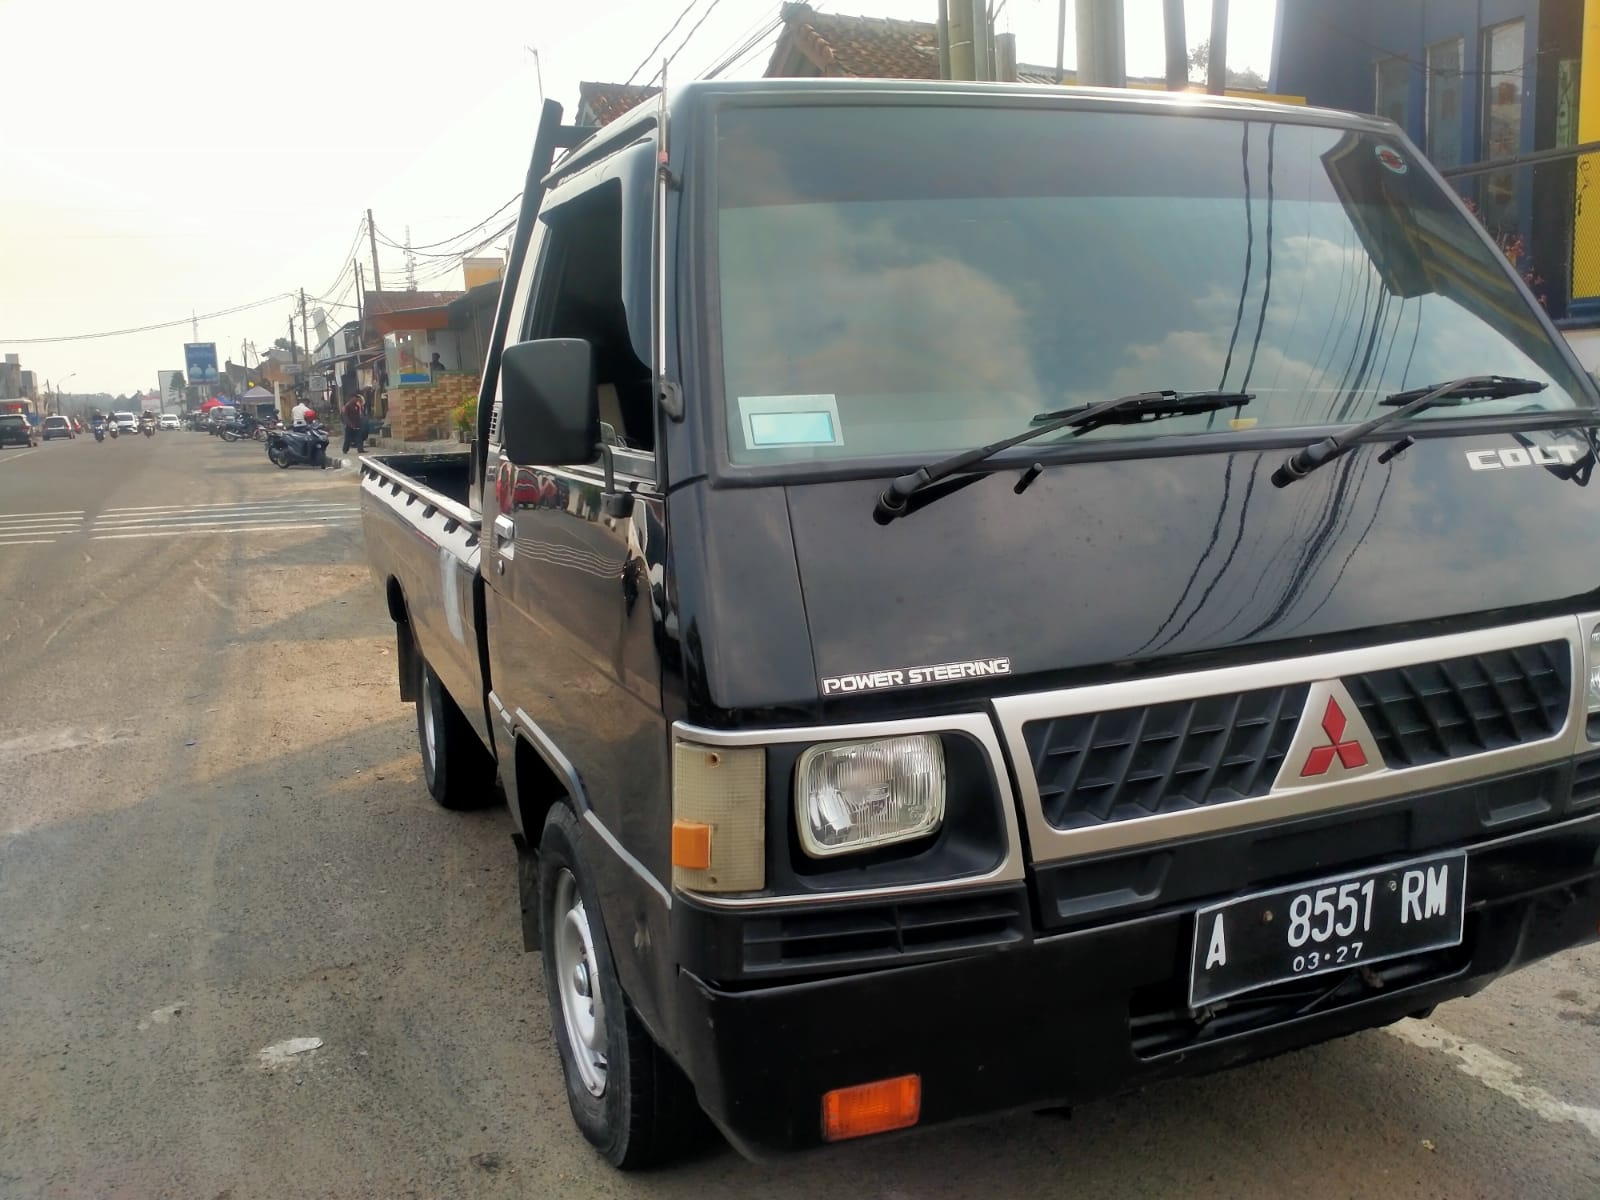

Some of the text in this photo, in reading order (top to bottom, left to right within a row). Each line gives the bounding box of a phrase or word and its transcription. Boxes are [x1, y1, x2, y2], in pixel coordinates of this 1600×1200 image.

[1465, 444, 1579, 471] COLT
[823, 659, 1010, 694] POWER STEERING
[1205, 864, 1448, 970] A 8551 RM
